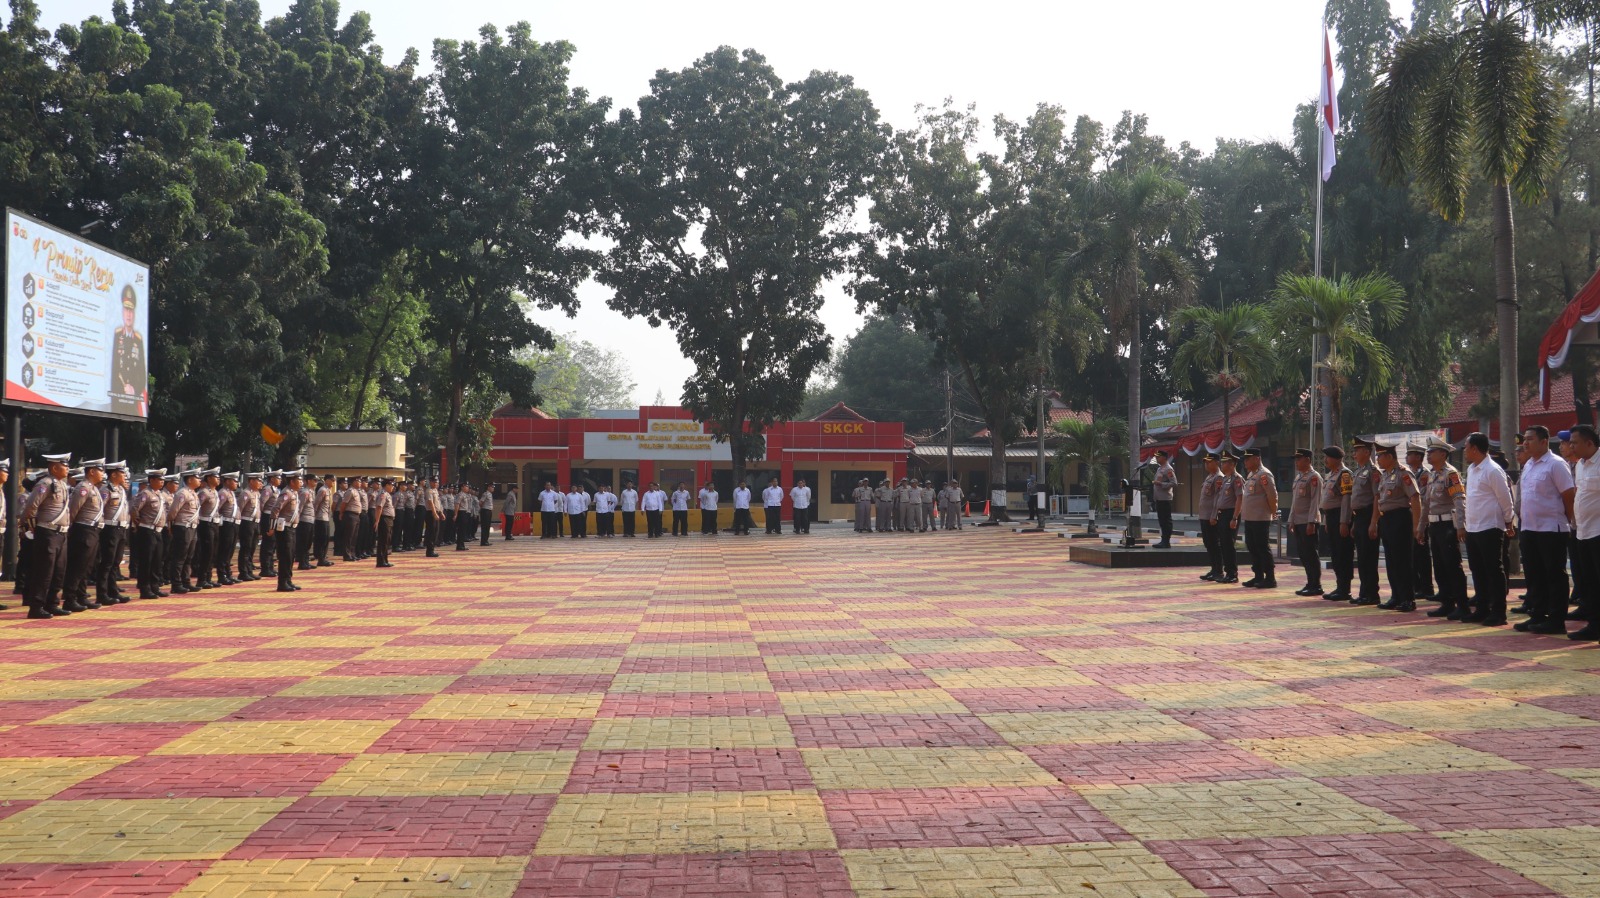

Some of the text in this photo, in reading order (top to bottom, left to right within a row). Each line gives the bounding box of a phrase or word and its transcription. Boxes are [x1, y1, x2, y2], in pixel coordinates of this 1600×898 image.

[33, 237, 41, 259] 4
[42, 240, 83, 280] Prinsip
[84, 255, 115, 292] Kerja
[651, 422, 700, 432] GEDUNG
[823, 423, 864, 434] SKCK
